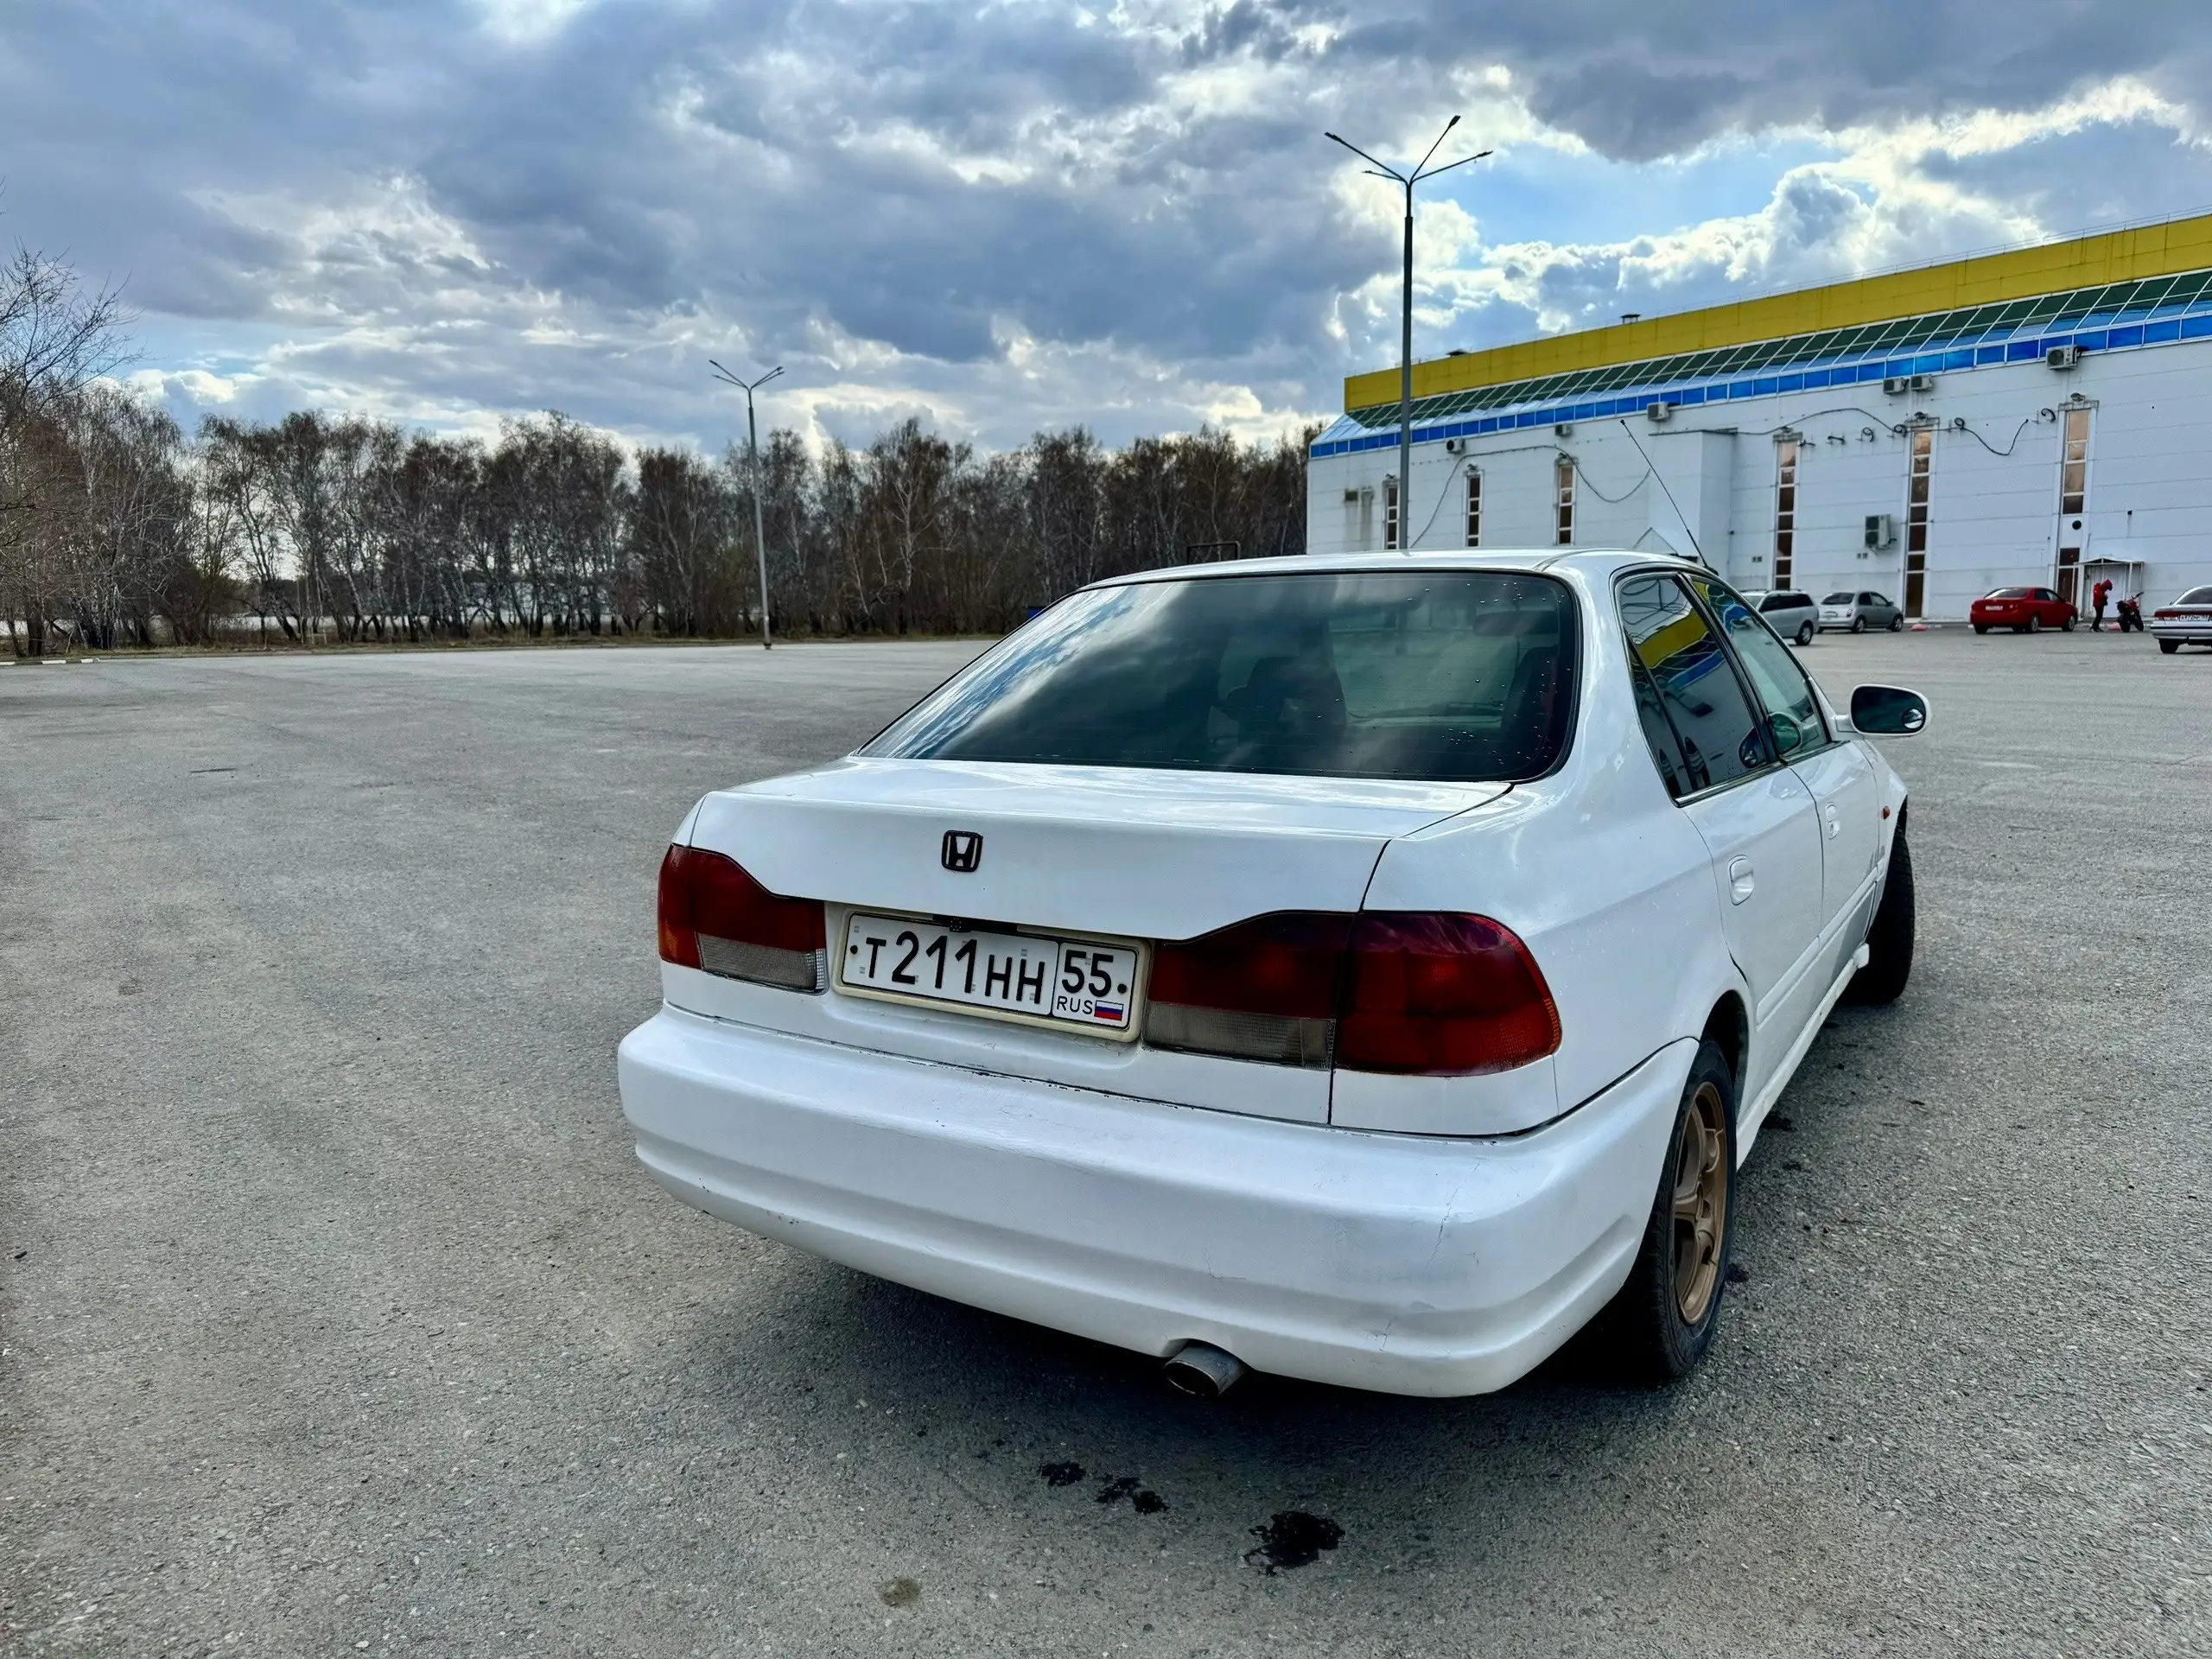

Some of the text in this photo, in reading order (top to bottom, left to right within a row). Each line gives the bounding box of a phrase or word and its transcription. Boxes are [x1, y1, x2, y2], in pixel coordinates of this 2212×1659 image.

[866, 931, 1114, 1004] Т211НН 55
[1057, 995, 1093, 1014] RUS
